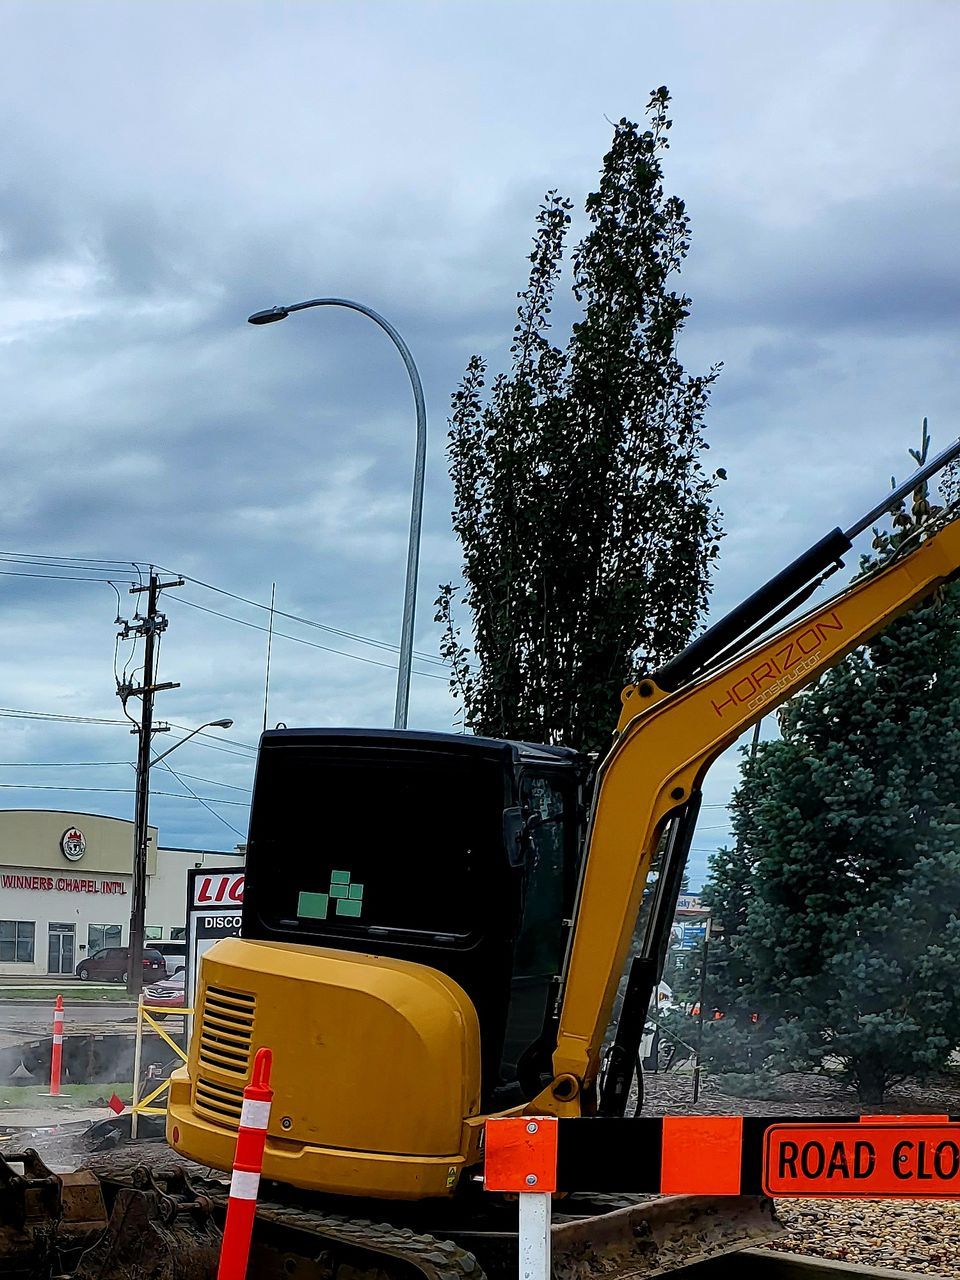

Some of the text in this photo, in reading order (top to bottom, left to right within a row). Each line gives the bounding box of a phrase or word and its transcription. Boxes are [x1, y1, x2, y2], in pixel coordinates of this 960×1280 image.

[711, 612, 843, 717] HORIZON
[747, 650, 822, 710] constructor
[1, 875, 54, 890] WINNERS
[55, 878, 100, 893] CHAPEL
[204, 917, 242, 928] DISCO
[778, 1141, 960, 1180] ROAD CLO
